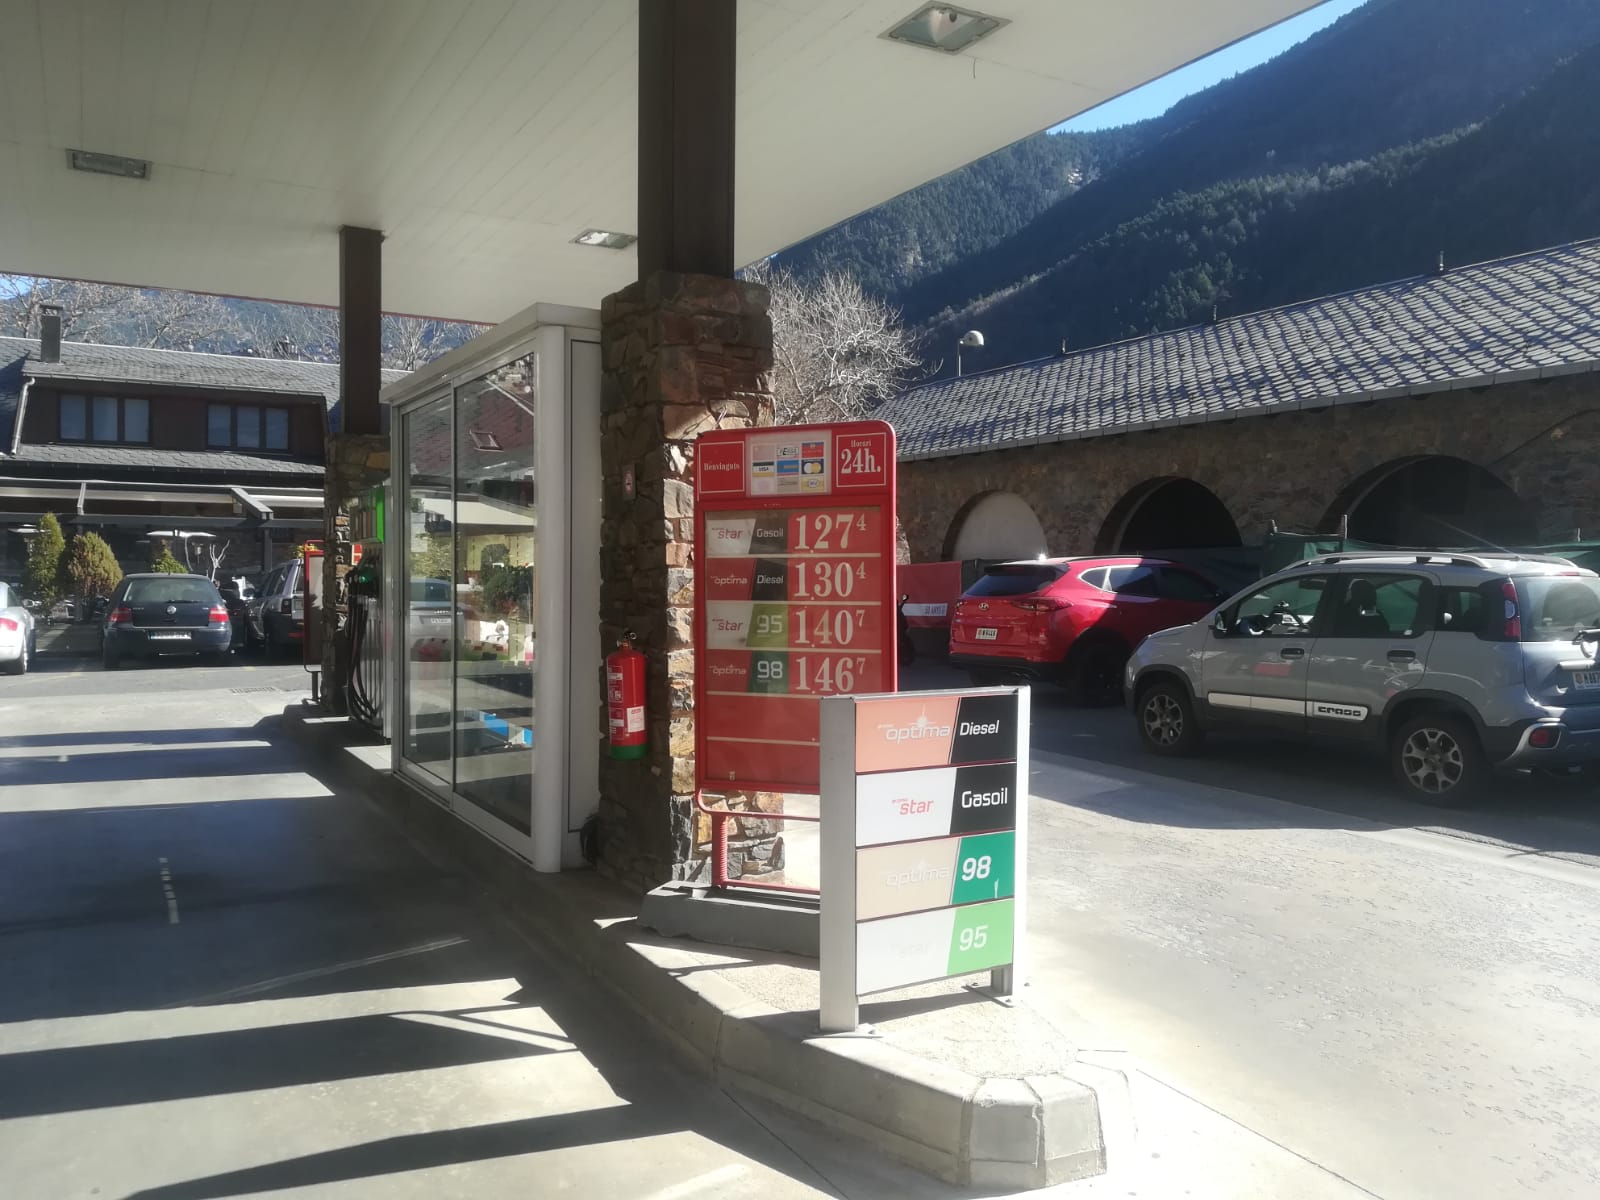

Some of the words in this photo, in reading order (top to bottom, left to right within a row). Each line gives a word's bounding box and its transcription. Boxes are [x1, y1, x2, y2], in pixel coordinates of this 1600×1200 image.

[850, 439, 872, 448] Horari
[841, 448, 881, 474] 24h.
[717, 527, 743, 540] star
[756, 527, 784, 538] Gasoil
[713, 575, 748, 587] optima
[756, 574, 784, 585] Diesel
[717, 620, 744, 632] star
[756, 614, 783, 633] 95
[712, 665, 747, 677] optima
[757, 660, 783, 679] 98
[886, 723, 951, 745] optima
[959, 719, 1000, 737] Diesel
[899, 799, 934, 816] star
[961, 787, 1008, 809] Gasoil
[961, 855, 992, 882] 98
[959, 924, 988, 952] 95
